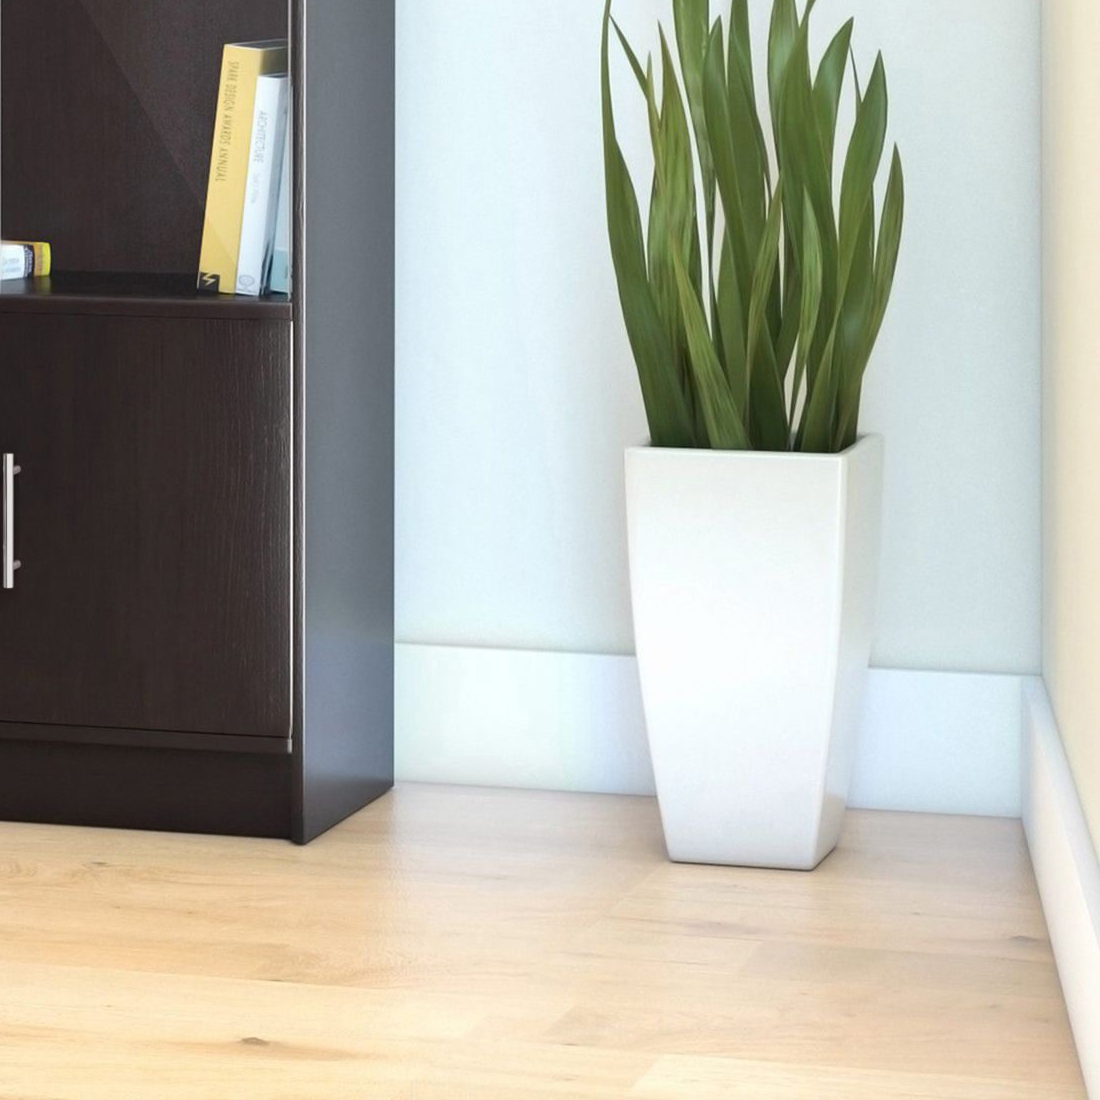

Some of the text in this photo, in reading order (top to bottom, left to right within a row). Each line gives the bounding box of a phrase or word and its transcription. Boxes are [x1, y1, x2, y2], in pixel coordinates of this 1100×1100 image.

[223, 84, 237, 112] DESIGN
[220, 113, 233, 146] AWARDS
[215, 147, 229, 182] ANNUAL
